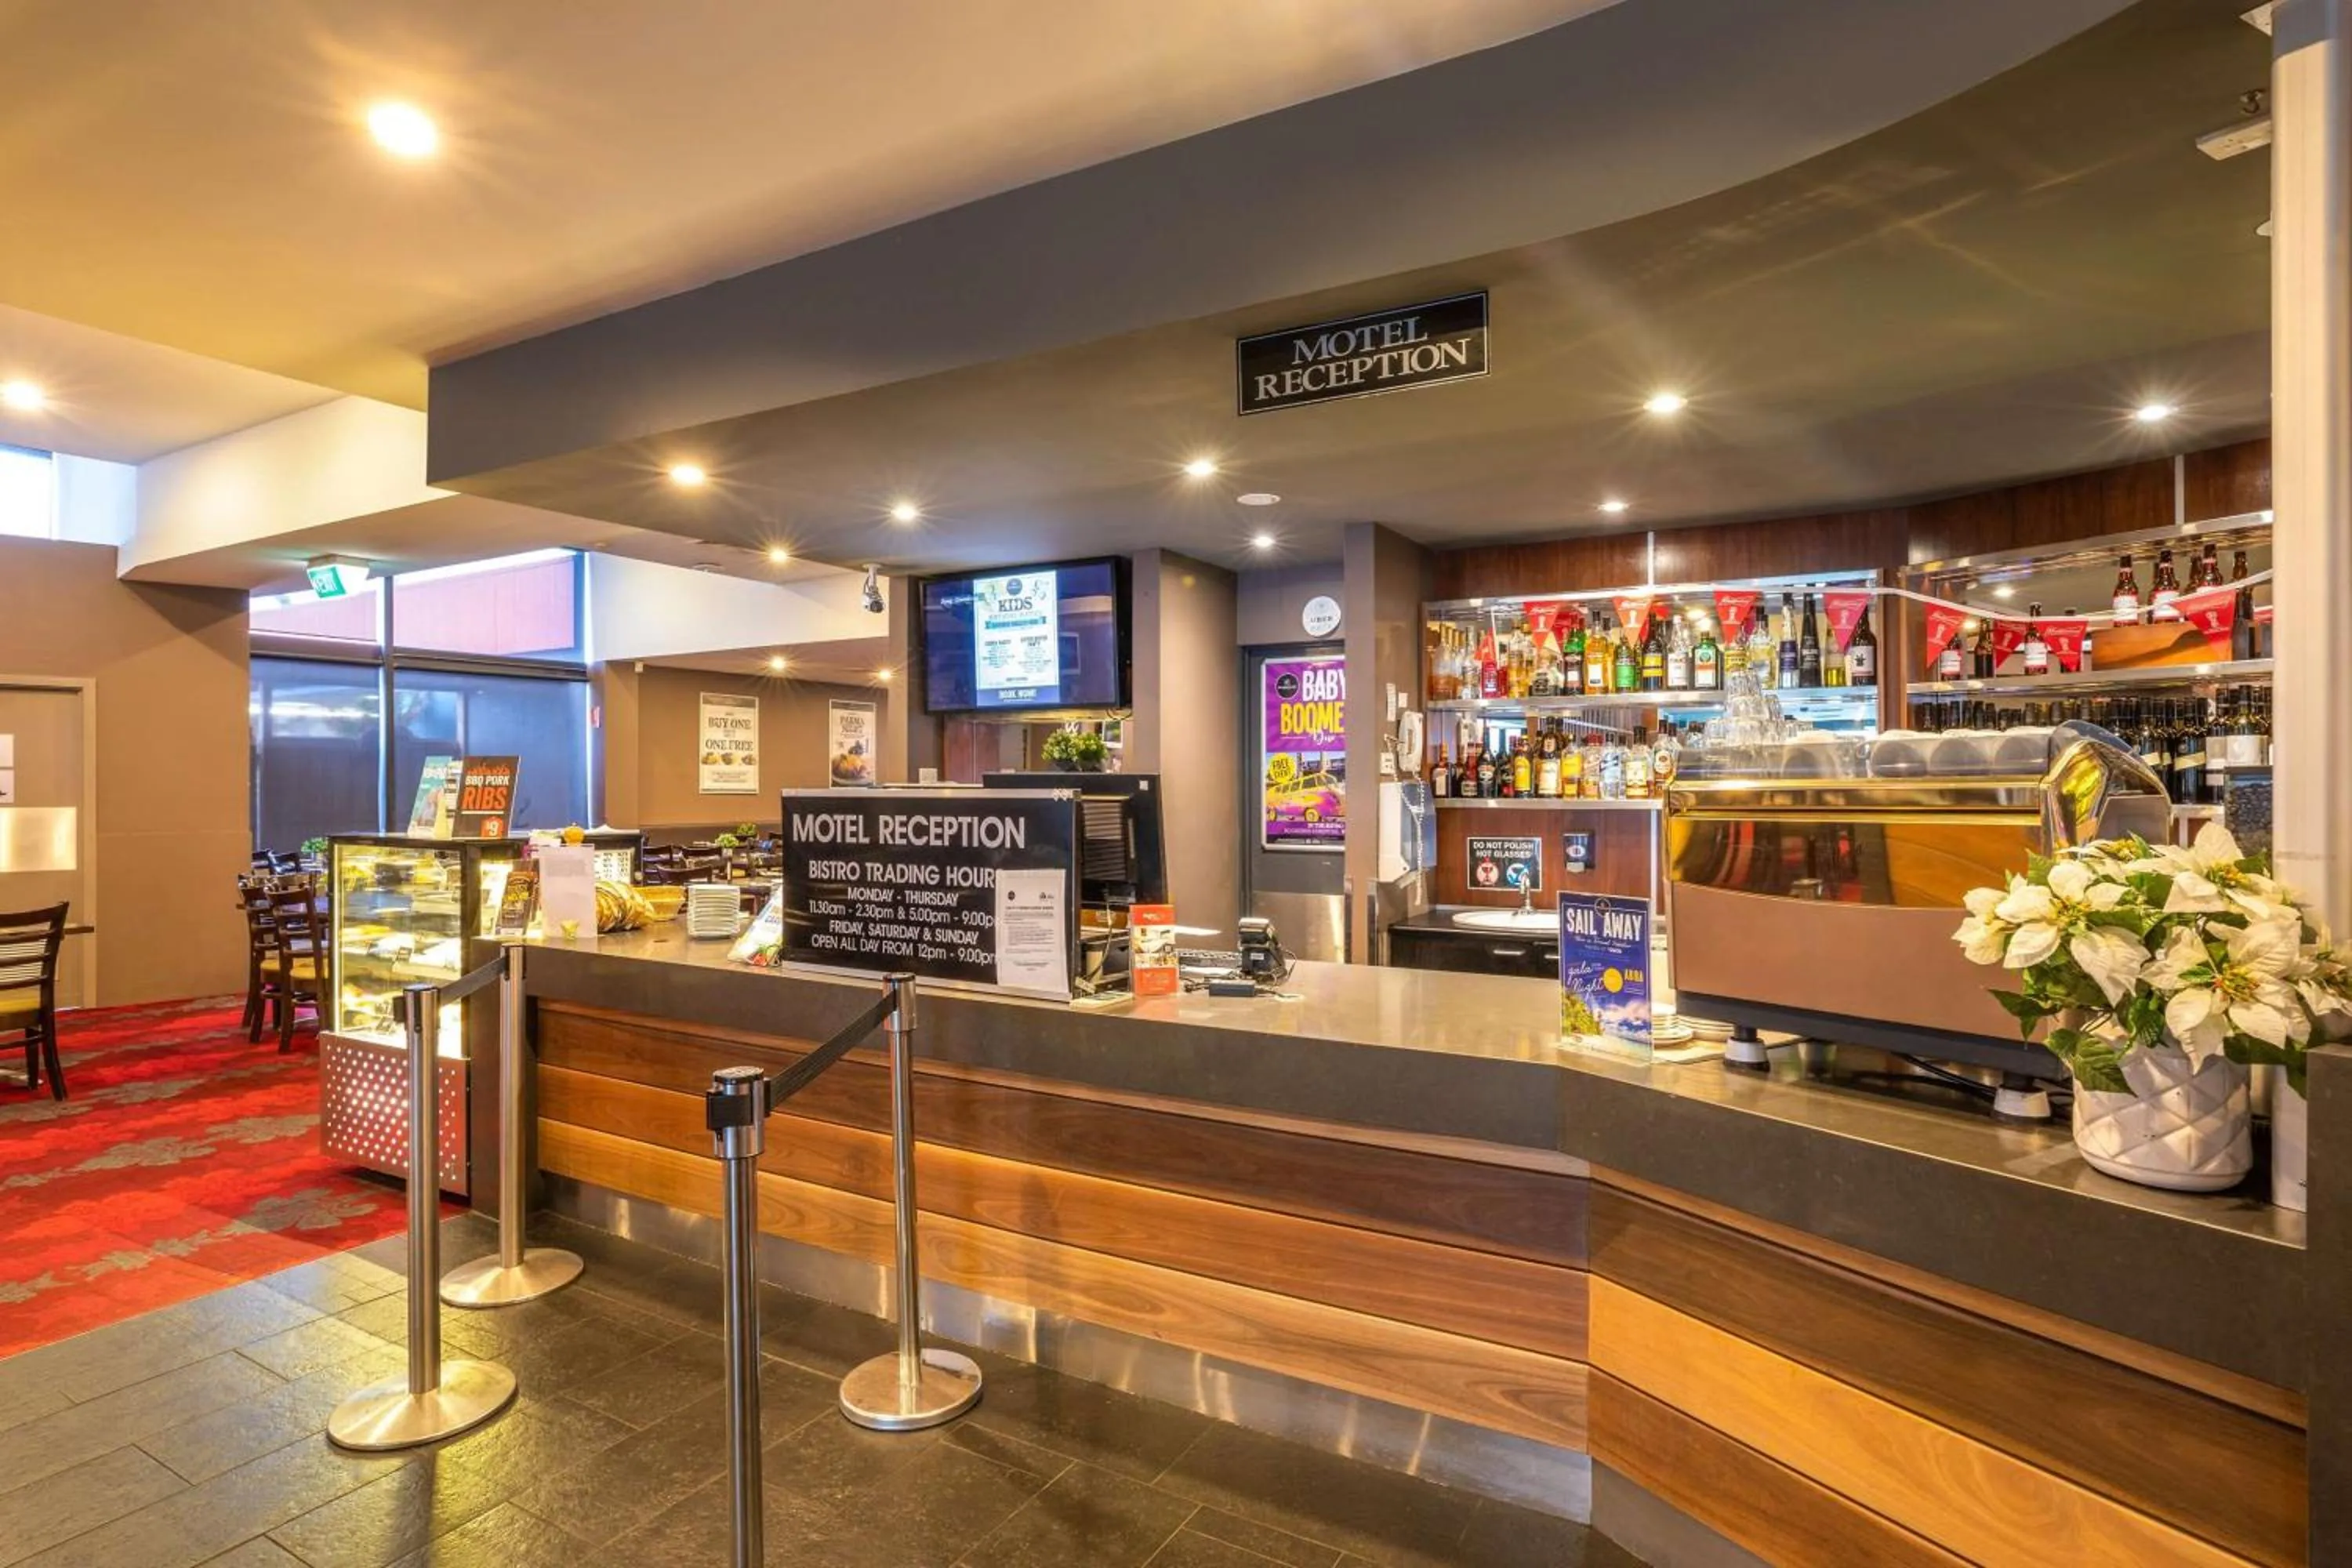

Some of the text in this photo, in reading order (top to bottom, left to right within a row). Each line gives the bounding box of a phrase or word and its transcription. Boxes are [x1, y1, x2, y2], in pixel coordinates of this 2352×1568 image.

[1292, 316, 1428, 365] MOTEL
[1254, 338, 1472, 401] RECEPTION
[998, 596, 1033, 612] KIDS
[1302, 669, 1345, 702] BABY
[708, 716, 752, 730] BUY ONE
[1279, 702, 1345, 735] BOOME
[706, 739, 753, 752] ONE FREE
[465, 775, 510, 787] BBQ PORK
[460, 786, 508, 810] RIBS
[793, 813, 1025, 849] MOTEL RECEPTION
[1494, 850, 1533, 858] GLASSES
[808, 860, 999, 888] BISTRO TRADING HOUR
[848, 887, 895, 902] MONDAY
[905, 890, 959, 907] THURSDAY
[855, 904, 895, 920] 2.30pm
[898, 907, 906, 920] &
[909, 907, 950, 924] 5.00pm
[962, 910, 996, 929] 9.00p
[1566, 908, 1642, 941] SAIL AWAY
[829, 920, 979, 945] FRIDAY, SATURDAY & SUNDAY
[811, 935, 838, 948] OPEN
[840, 937, 857, 951] ALL
[860, 938, 879, 953] DAY
[882, 941, 913, 956] FROM
[918, 944, 946, 962] 12pm
